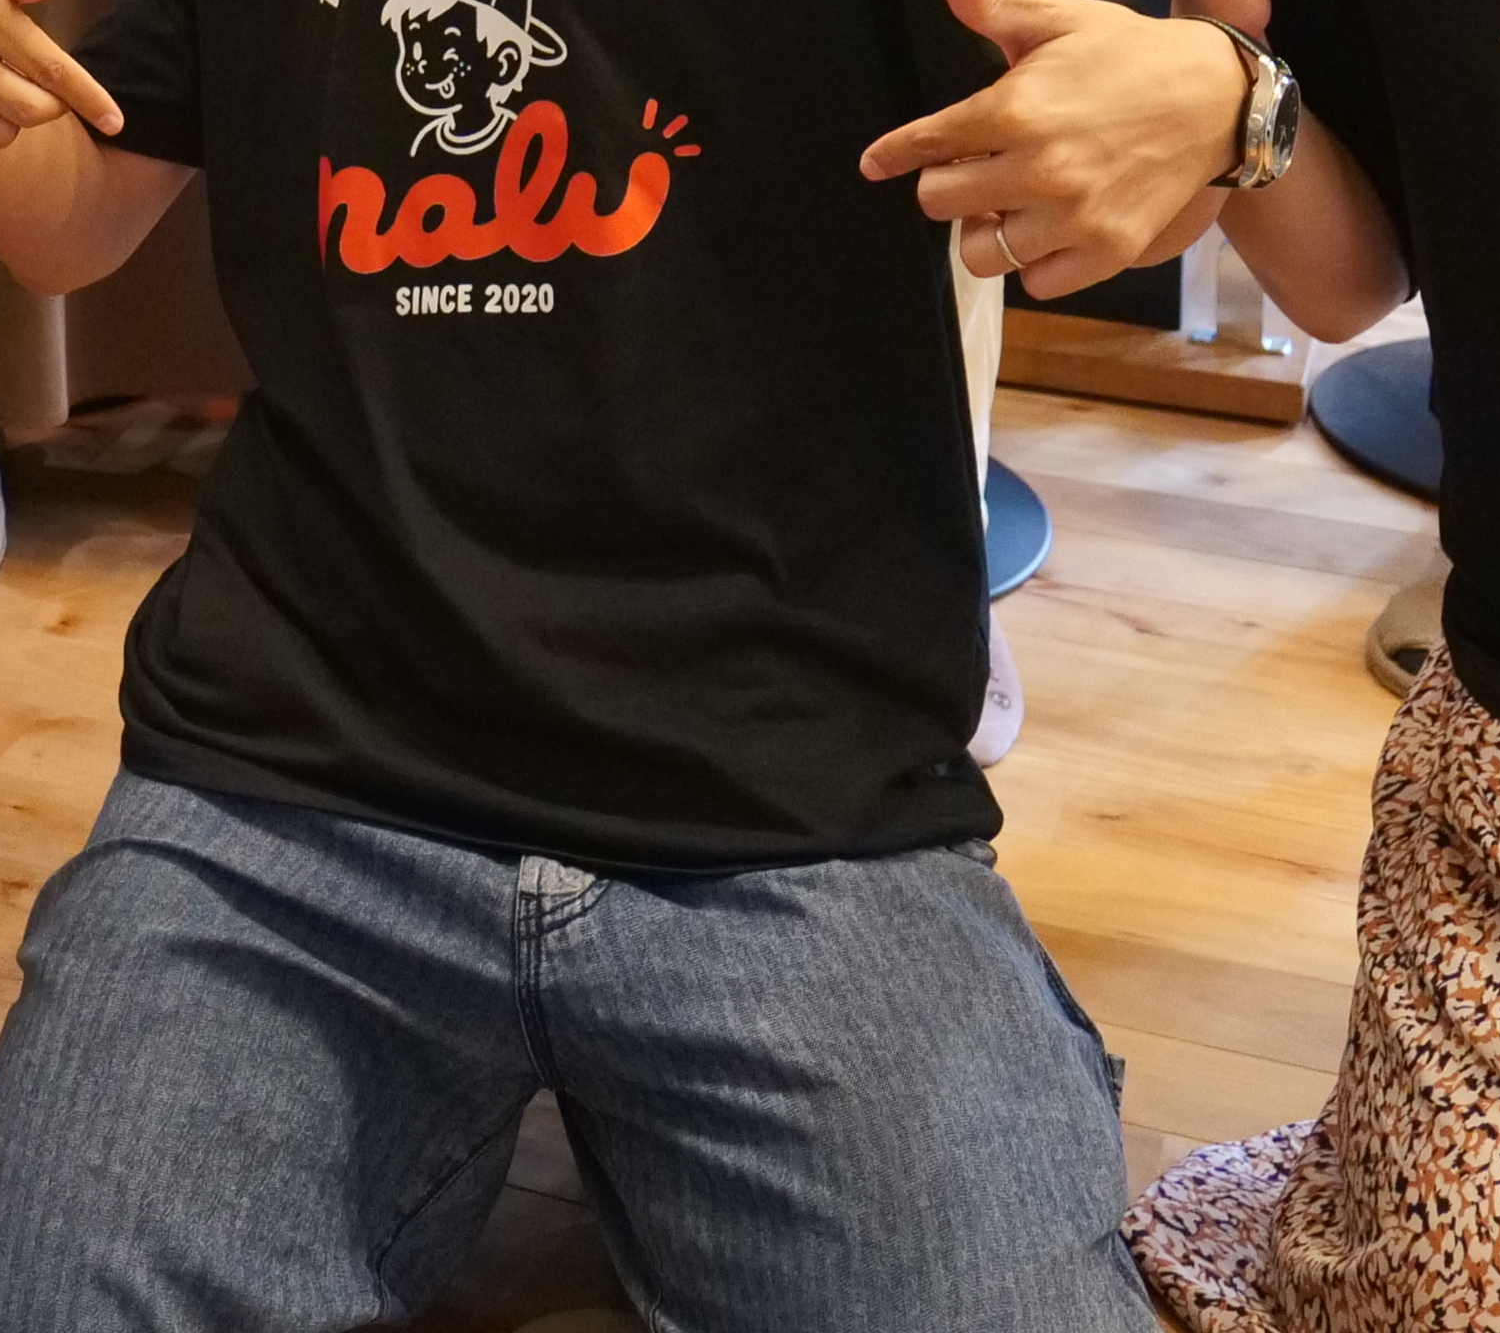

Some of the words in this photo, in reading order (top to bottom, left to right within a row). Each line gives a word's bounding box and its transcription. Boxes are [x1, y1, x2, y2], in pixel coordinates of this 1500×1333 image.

[317, 99, 671, 275] nalu
[395, 283, 473, 316] SINCE
[484, 283, 555, 314] 2020
